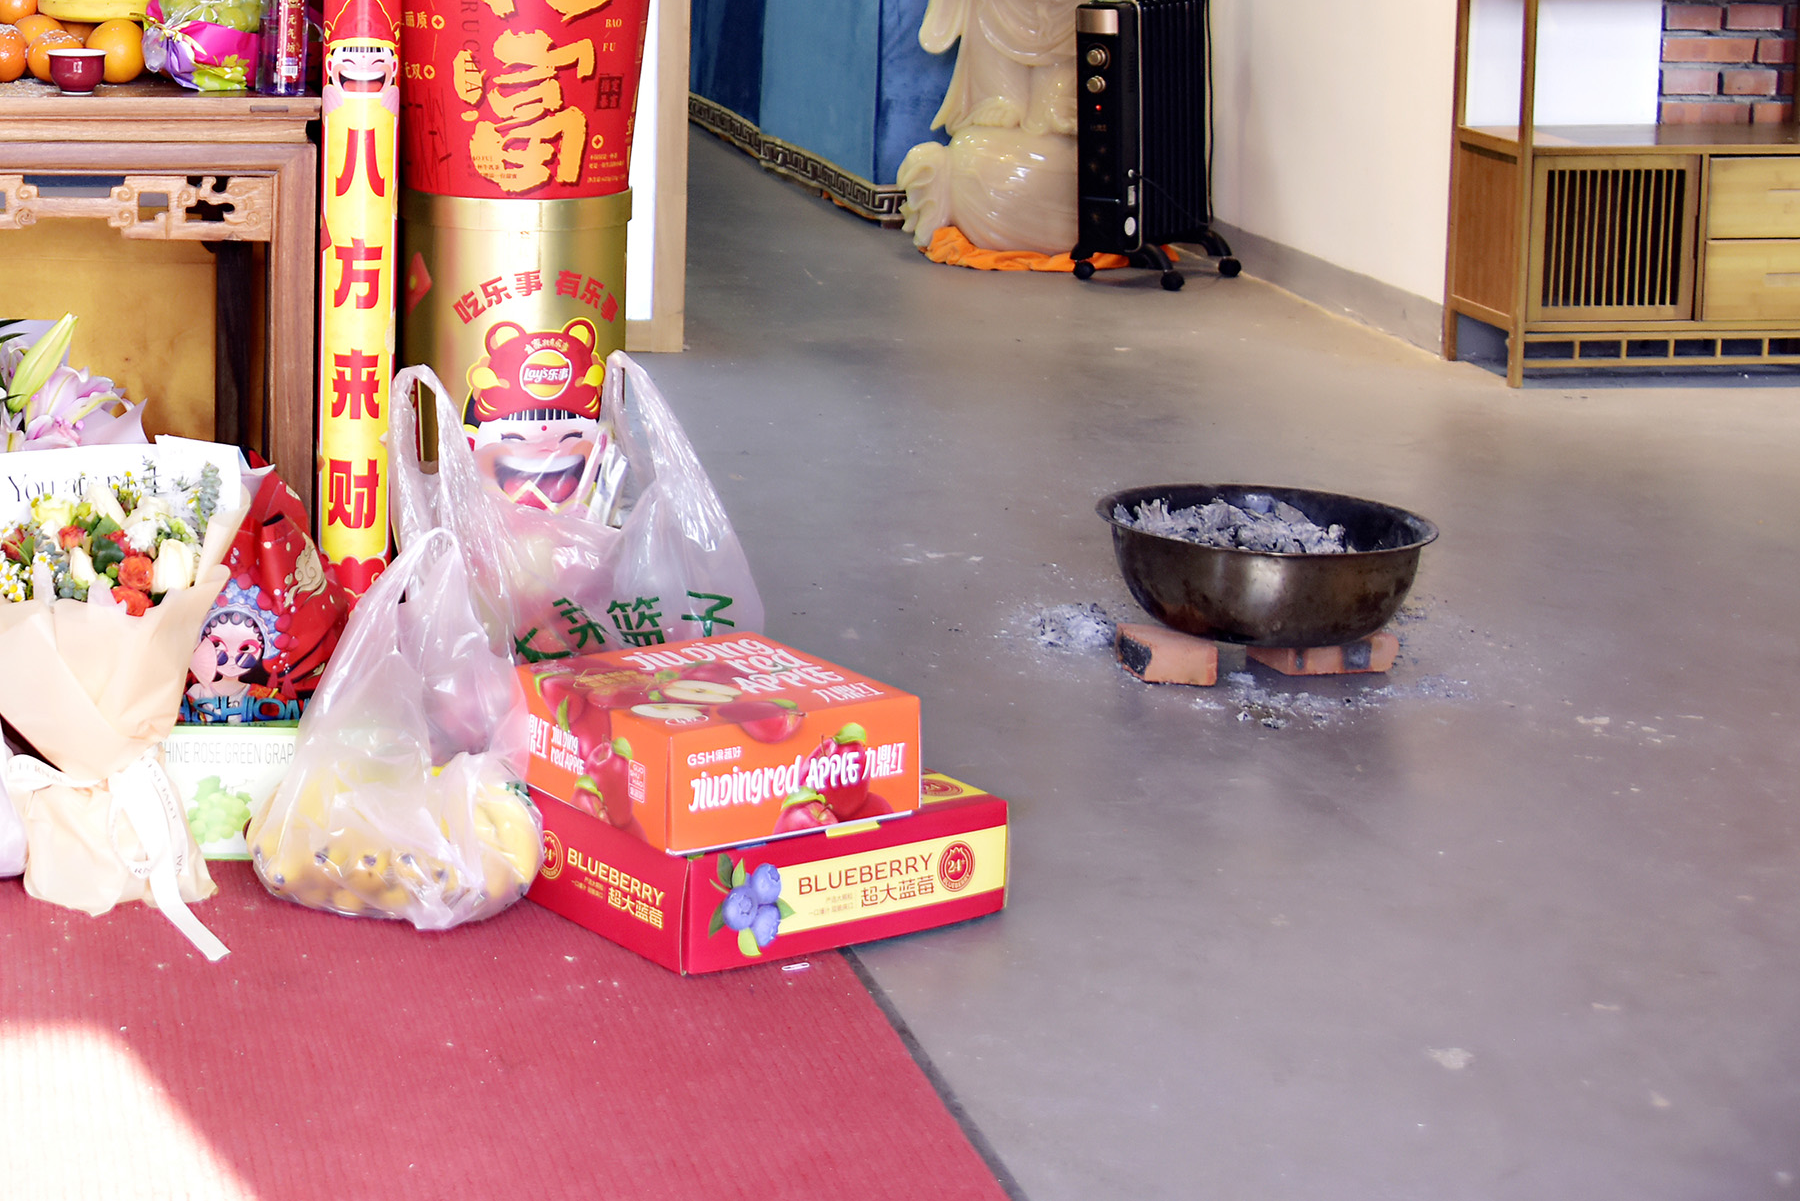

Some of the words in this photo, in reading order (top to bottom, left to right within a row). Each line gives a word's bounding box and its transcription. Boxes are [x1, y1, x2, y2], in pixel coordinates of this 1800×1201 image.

[605, 17, 622, 28] BAO
[602, 42, 616, 53] FU
[453, 269, 543, 325] 吃乐事
[555, 269, 619, 324] 有乐事
[327, 128, 386, 529] 八方来财
[178, 694, 311, 723] ASHION
[811, 682, 885, 703] 九鼎红
[266, 743, 295, 764] GRAP
[861, 741, 906, 780] 九鼎红
[566, 846, 665, 907] BLUEBERRY
[798, 852, 933, 896] BLUEBERRY
[861, 874, 935, 908] 超大蓝莓
[607, 886, 664, 929] 超大蓝莓
